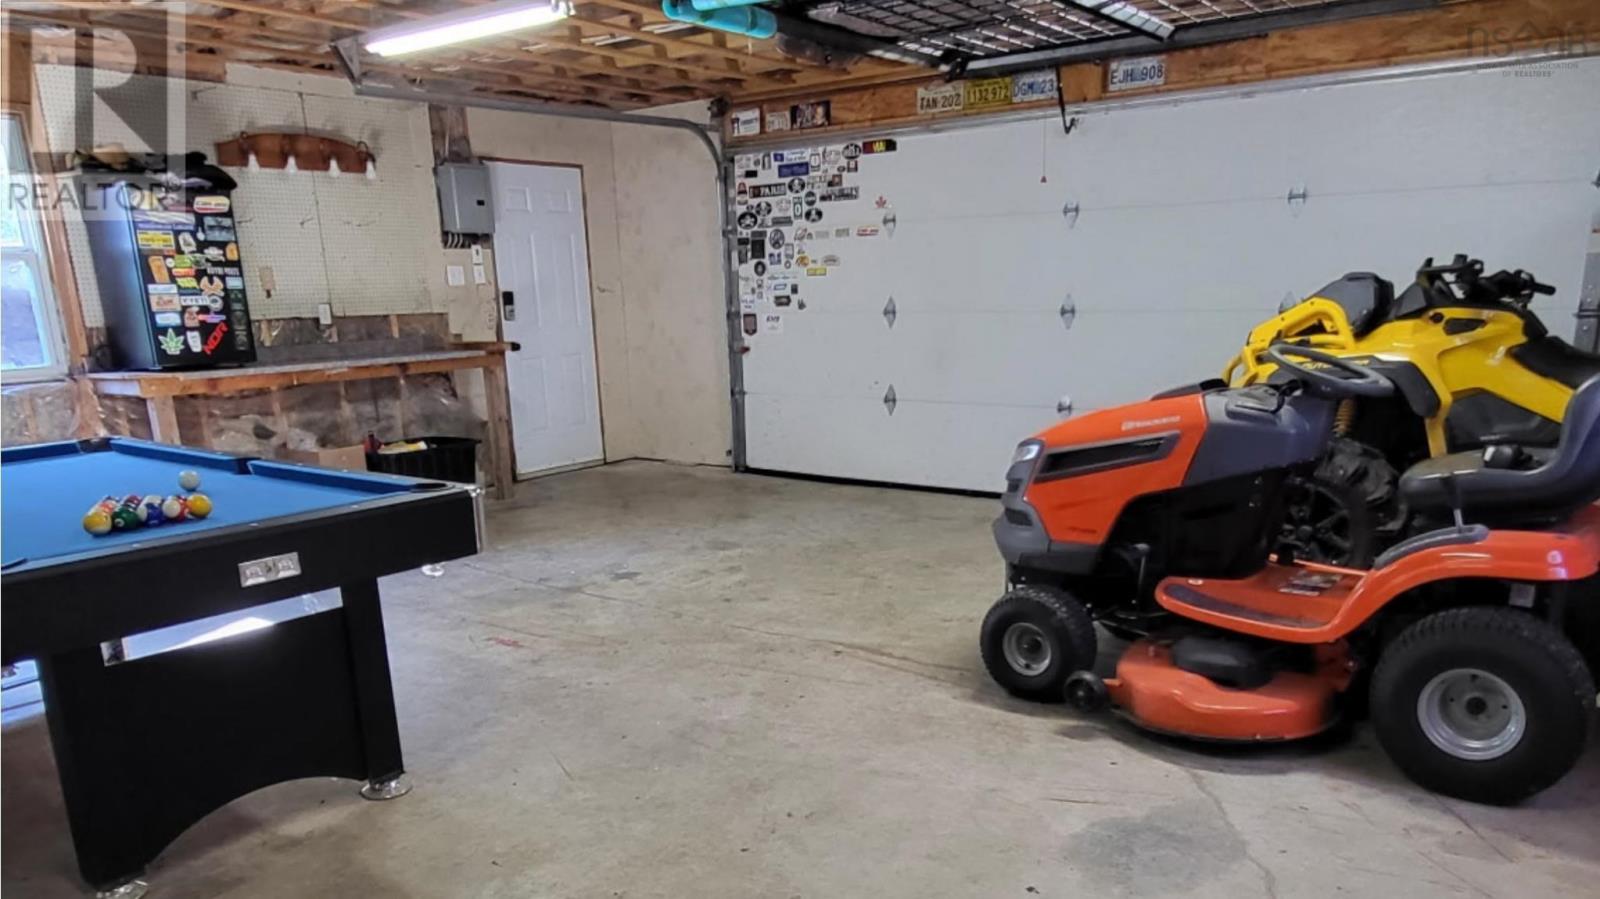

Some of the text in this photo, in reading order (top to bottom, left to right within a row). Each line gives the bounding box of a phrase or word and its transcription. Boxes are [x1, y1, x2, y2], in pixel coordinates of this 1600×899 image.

[1110, 63, 1164, 86] EJH 908
[941, 92, 961, 109] 202
